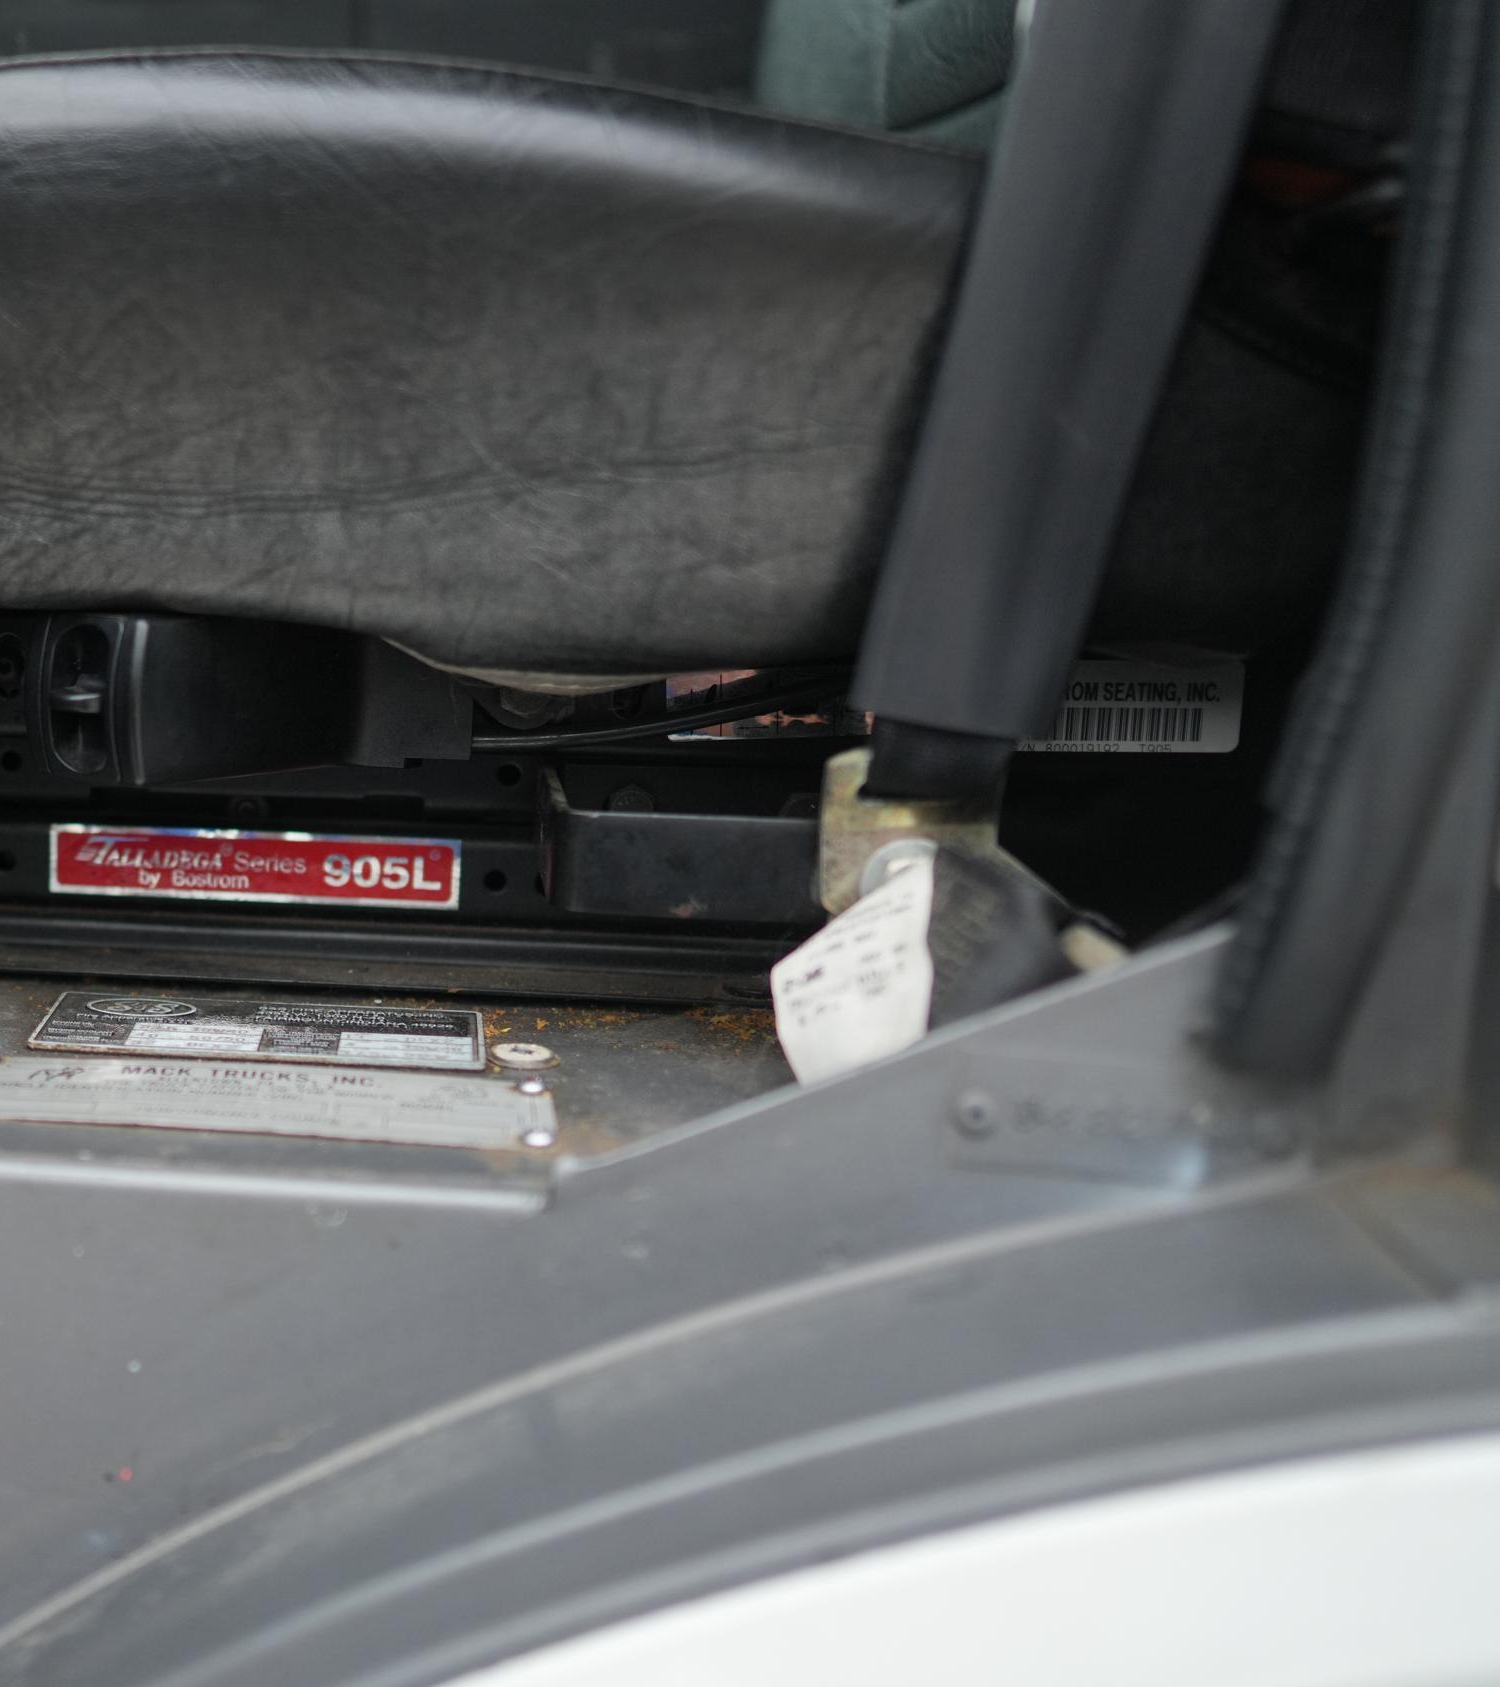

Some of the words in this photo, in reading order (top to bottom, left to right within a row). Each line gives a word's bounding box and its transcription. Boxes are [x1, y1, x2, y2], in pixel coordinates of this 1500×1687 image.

[1103, 682, 1181, 705] SEATING,
[1187, 682, 1220, 702] INC.
[76, 836, 222, 869] TALLADEGA
[233, 851, 307, 874] Series
[323, 853, 442, 892] 905L
[138, 869, 161, 889] by
[120, 1065, 192, 1077] MACK
